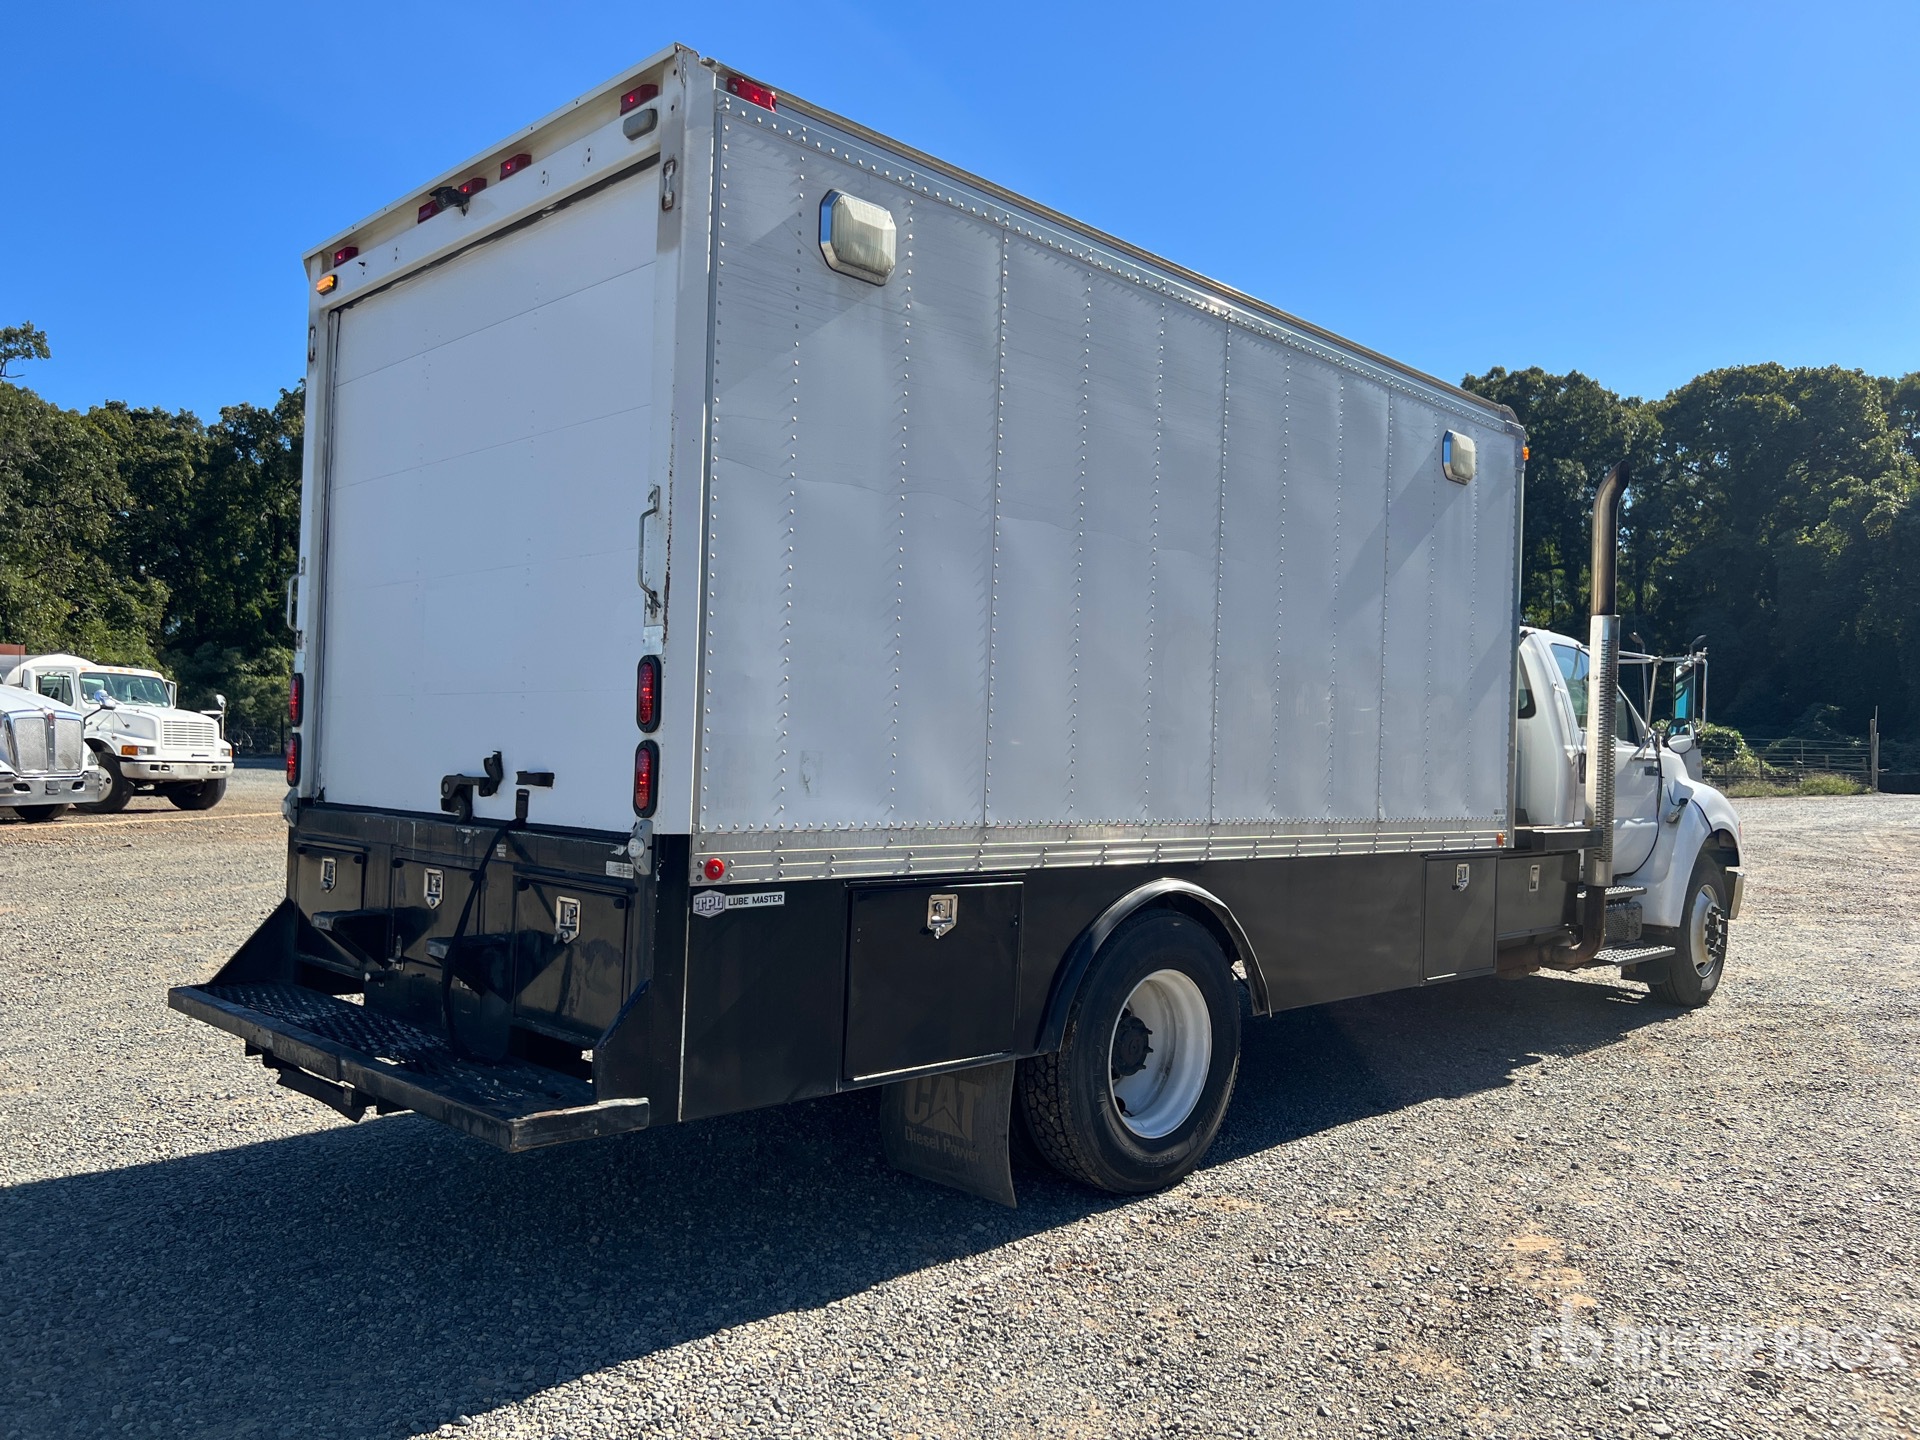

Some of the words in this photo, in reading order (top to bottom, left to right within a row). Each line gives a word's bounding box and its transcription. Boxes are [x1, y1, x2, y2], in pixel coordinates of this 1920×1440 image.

[695, 896, 723, 911] TPL
[728, 896, 749, 906] LUBE
[752, 894, 783, 905] MASTER
[904, 1076, 986, 1142] CAT
[904, 1125, 939, 1150] Diesel
[943, 1137, 982, 1164] Power
